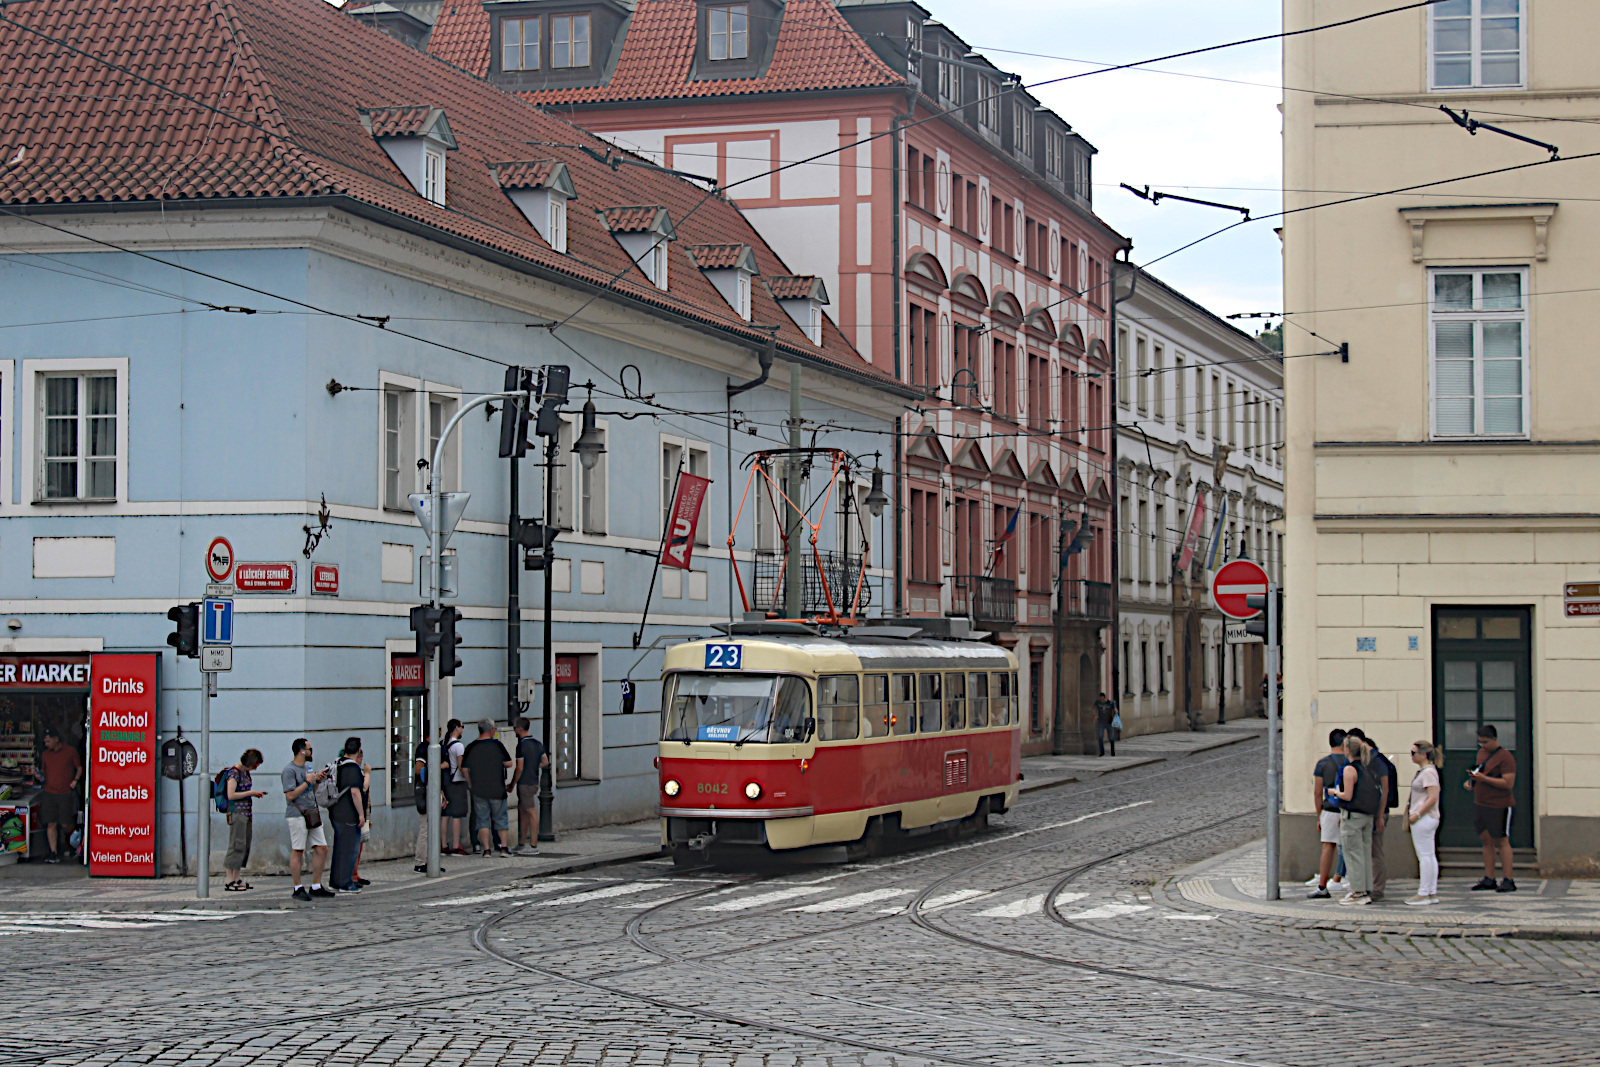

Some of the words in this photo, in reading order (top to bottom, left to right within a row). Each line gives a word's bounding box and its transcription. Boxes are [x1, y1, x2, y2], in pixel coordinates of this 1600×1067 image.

[688, 482, 702, 521] UNIVERSITY
[210, 649, 225, 657] MIMO
[709, 645, 739, 667] 23
[21, 664, 91, 682] MARKET
[394, 664, 422, 680] MARKET
[102, 677, 144, 694] Drinks
[621, 681, 630, 695] 23
[99, 711, 148, 728] Alkohol
[100, 730, 146, 743] EXCHANGE
[98, 747, 147, 767] Drogerie
[96, 785, 149, 800] Canabis
[697, 782, 729, 795] 8042
[95, 824, 126, 836] Thank
[128, 825, 150, 838] you!
[91, 851, 122, 863] Vielen
[124, 851, 154, 864] Dank!
